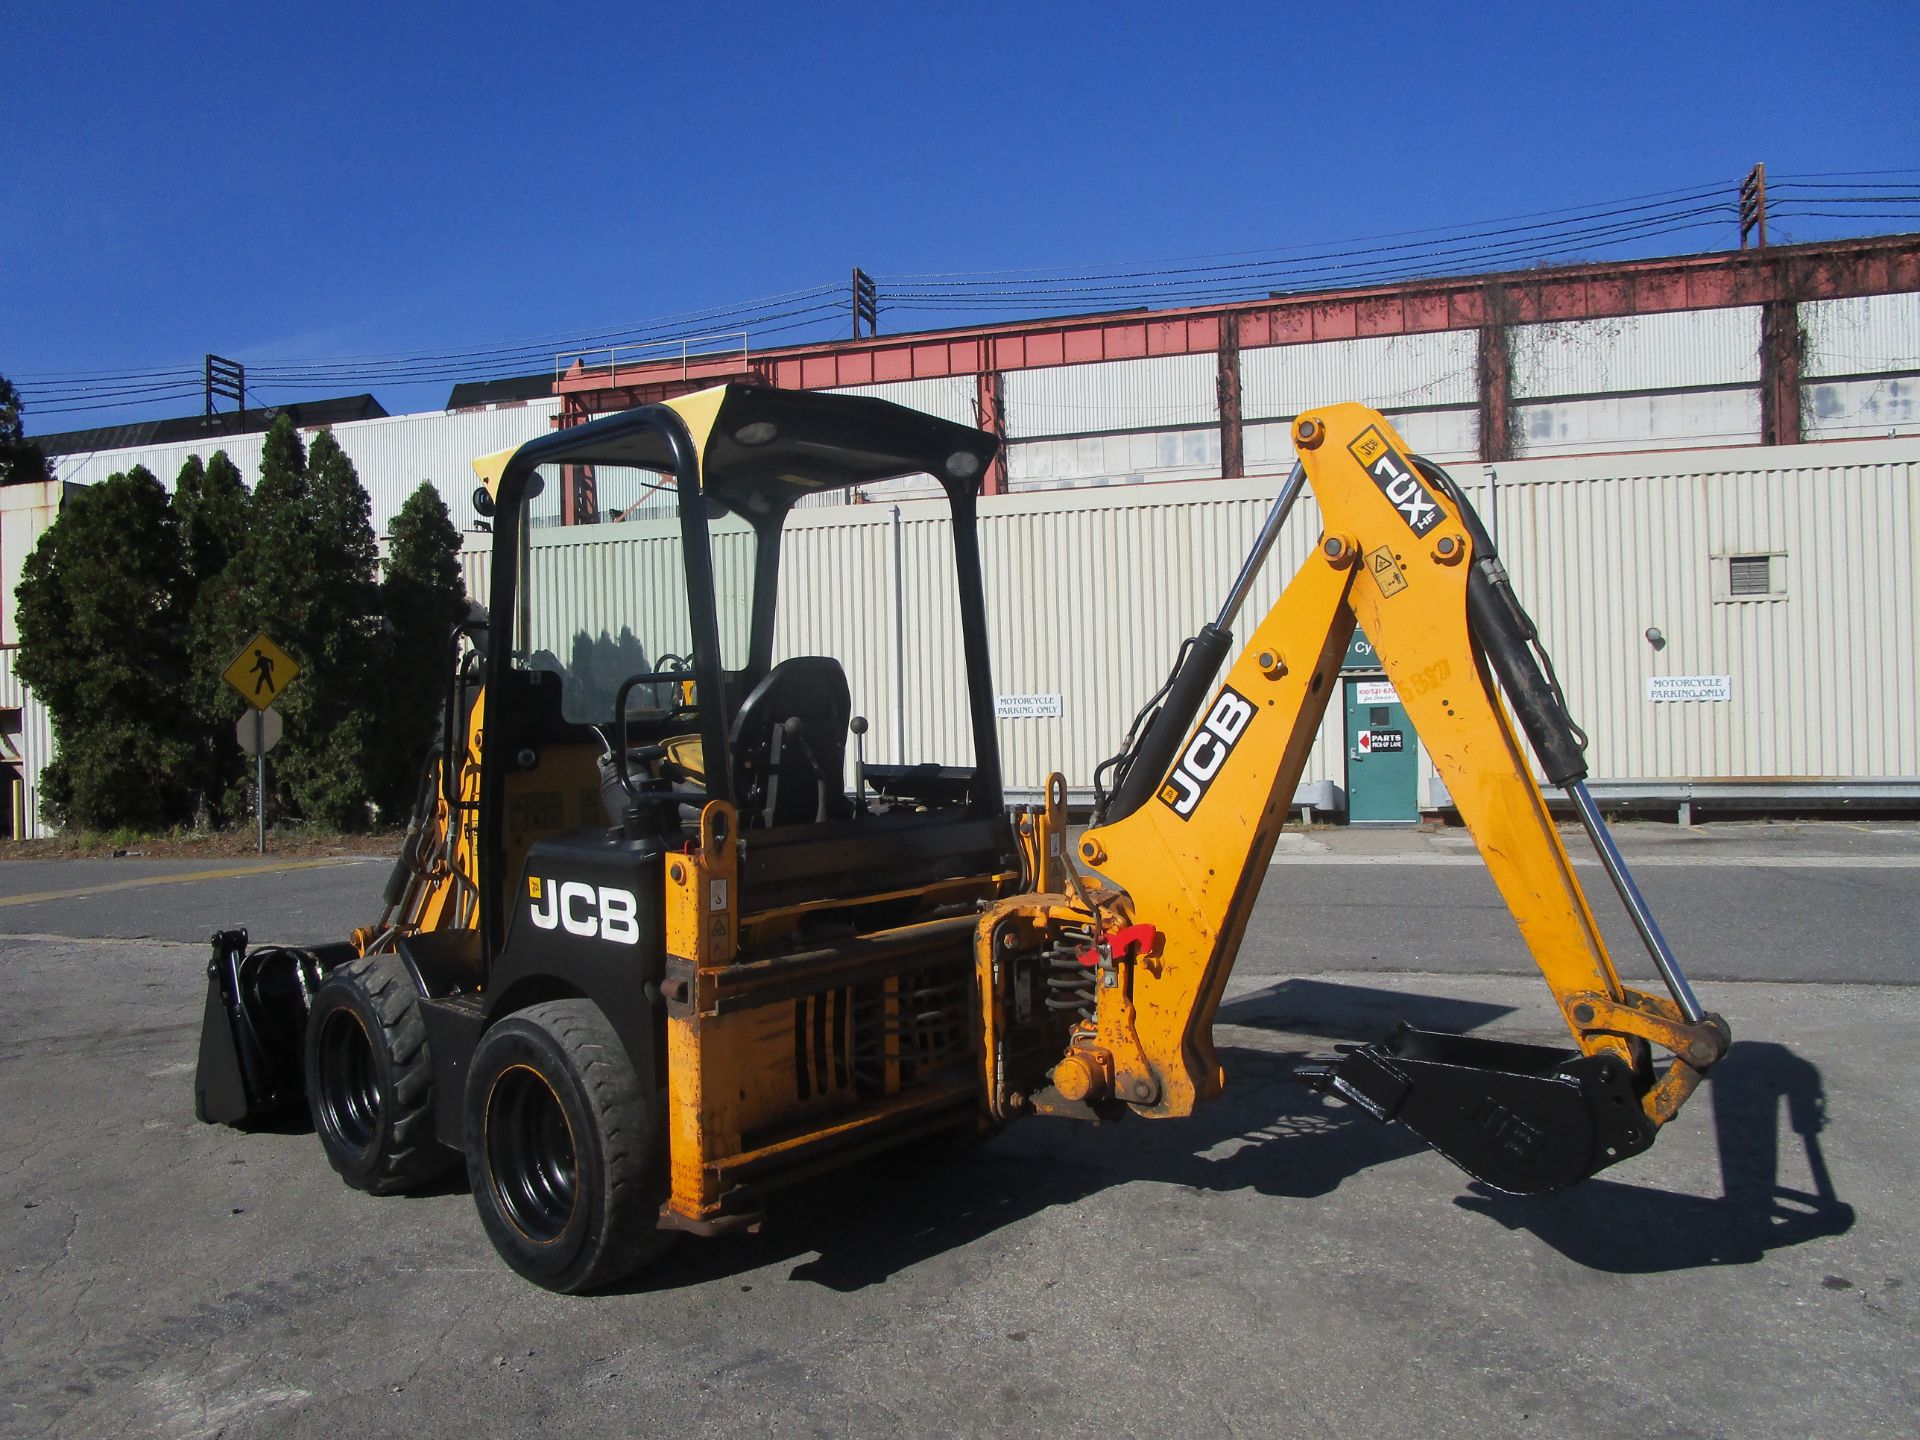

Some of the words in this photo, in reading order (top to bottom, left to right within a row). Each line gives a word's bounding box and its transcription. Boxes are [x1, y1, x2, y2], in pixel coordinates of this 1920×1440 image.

[1361, 438, 1379, 457] JCB
[1416, 510, 1436, 531] HF
[1654, 678, 1722, 688] MOTORCYCLE
[1651, 689, 1696, 698] PARKING
[1699, 688, 1726, 697] ONLY
[1000, 697, 1055, 705] MOTORCYCLE
[998, 706, 1034, 714] PARKING
[1036, 705, 1058, 714] ONLY
[1371, 734, 1402, 742] PARTS
[1172, 692, 1252, 814] JCB
[530, 878, 640, 945] JCB
